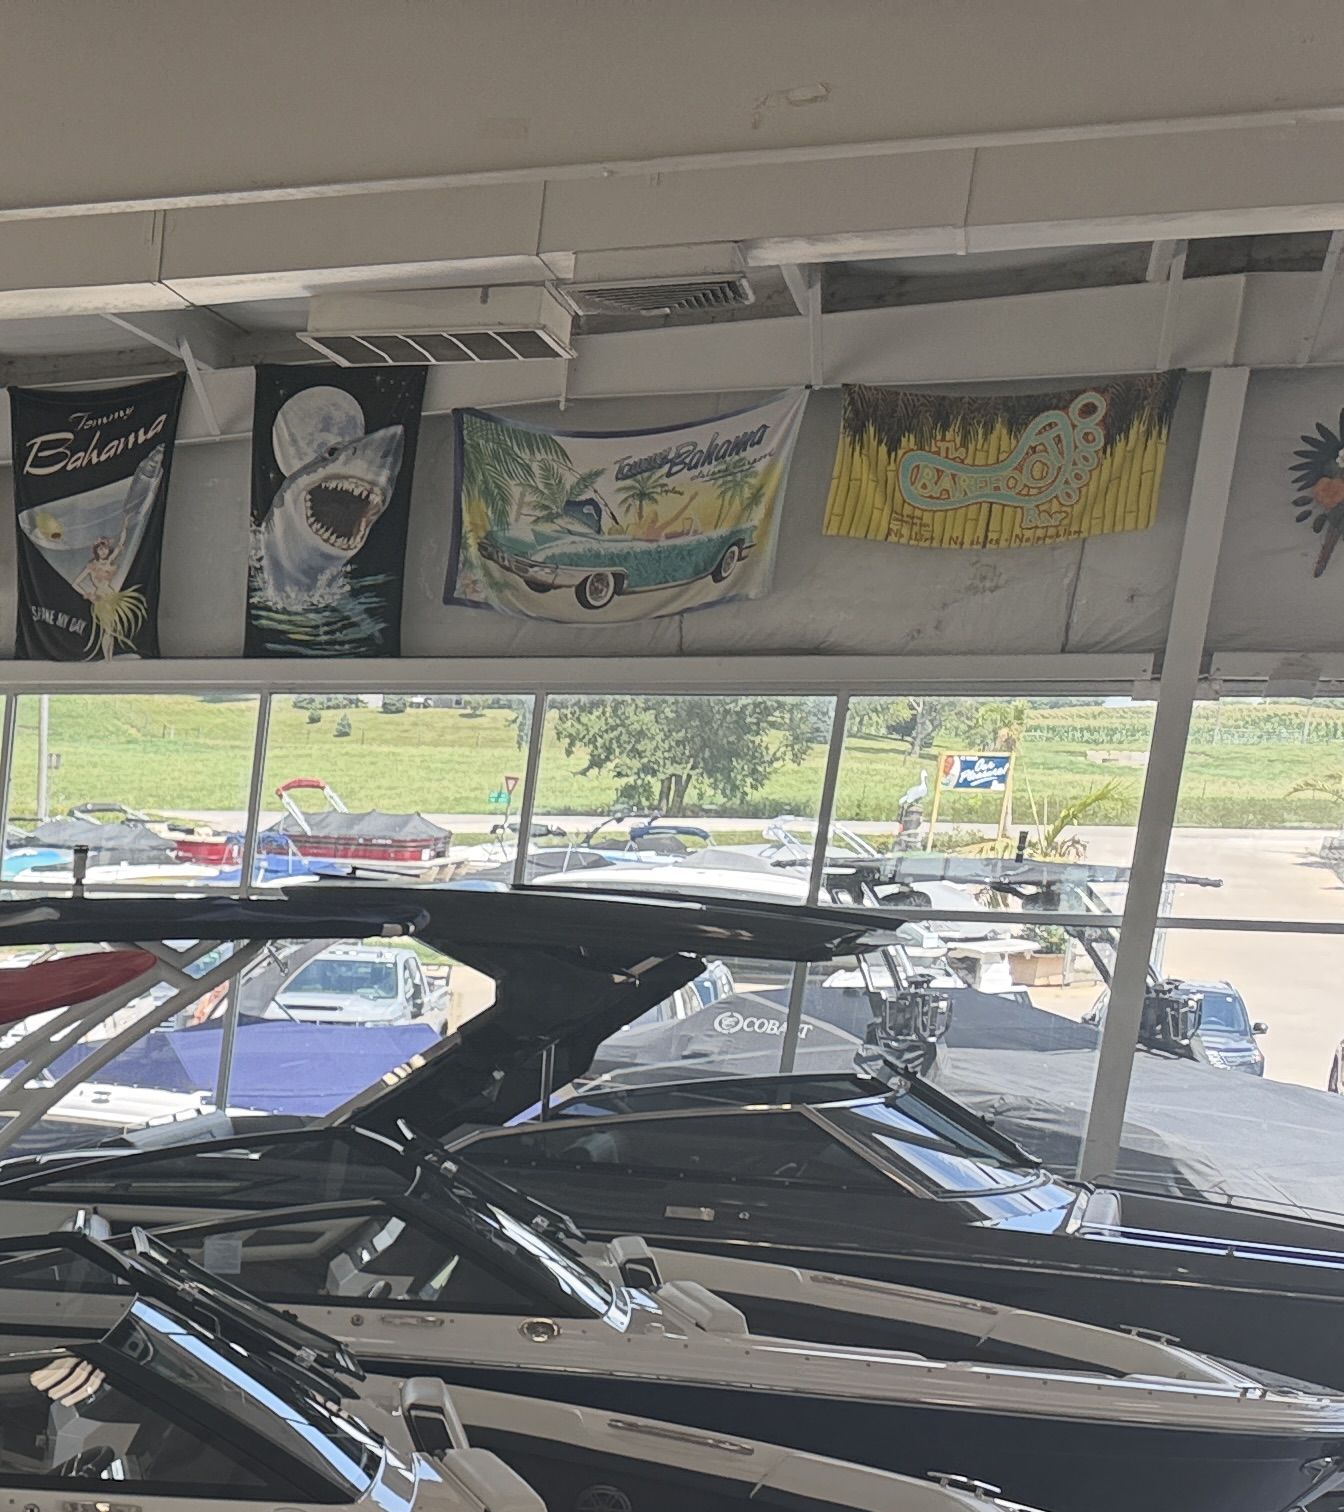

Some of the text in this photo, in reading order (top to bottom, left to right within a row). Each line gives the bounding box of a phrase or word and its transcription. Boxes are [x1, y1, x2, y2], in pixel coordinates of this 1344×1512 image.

[68, 404, 135, 431] Tommy
[23, 414, 168, 476] Bahama
[665, 423, 771, 478] Bahama
[69, 617, 87, 636] DAY
[742, 1016, 814, 1039] COBAT
